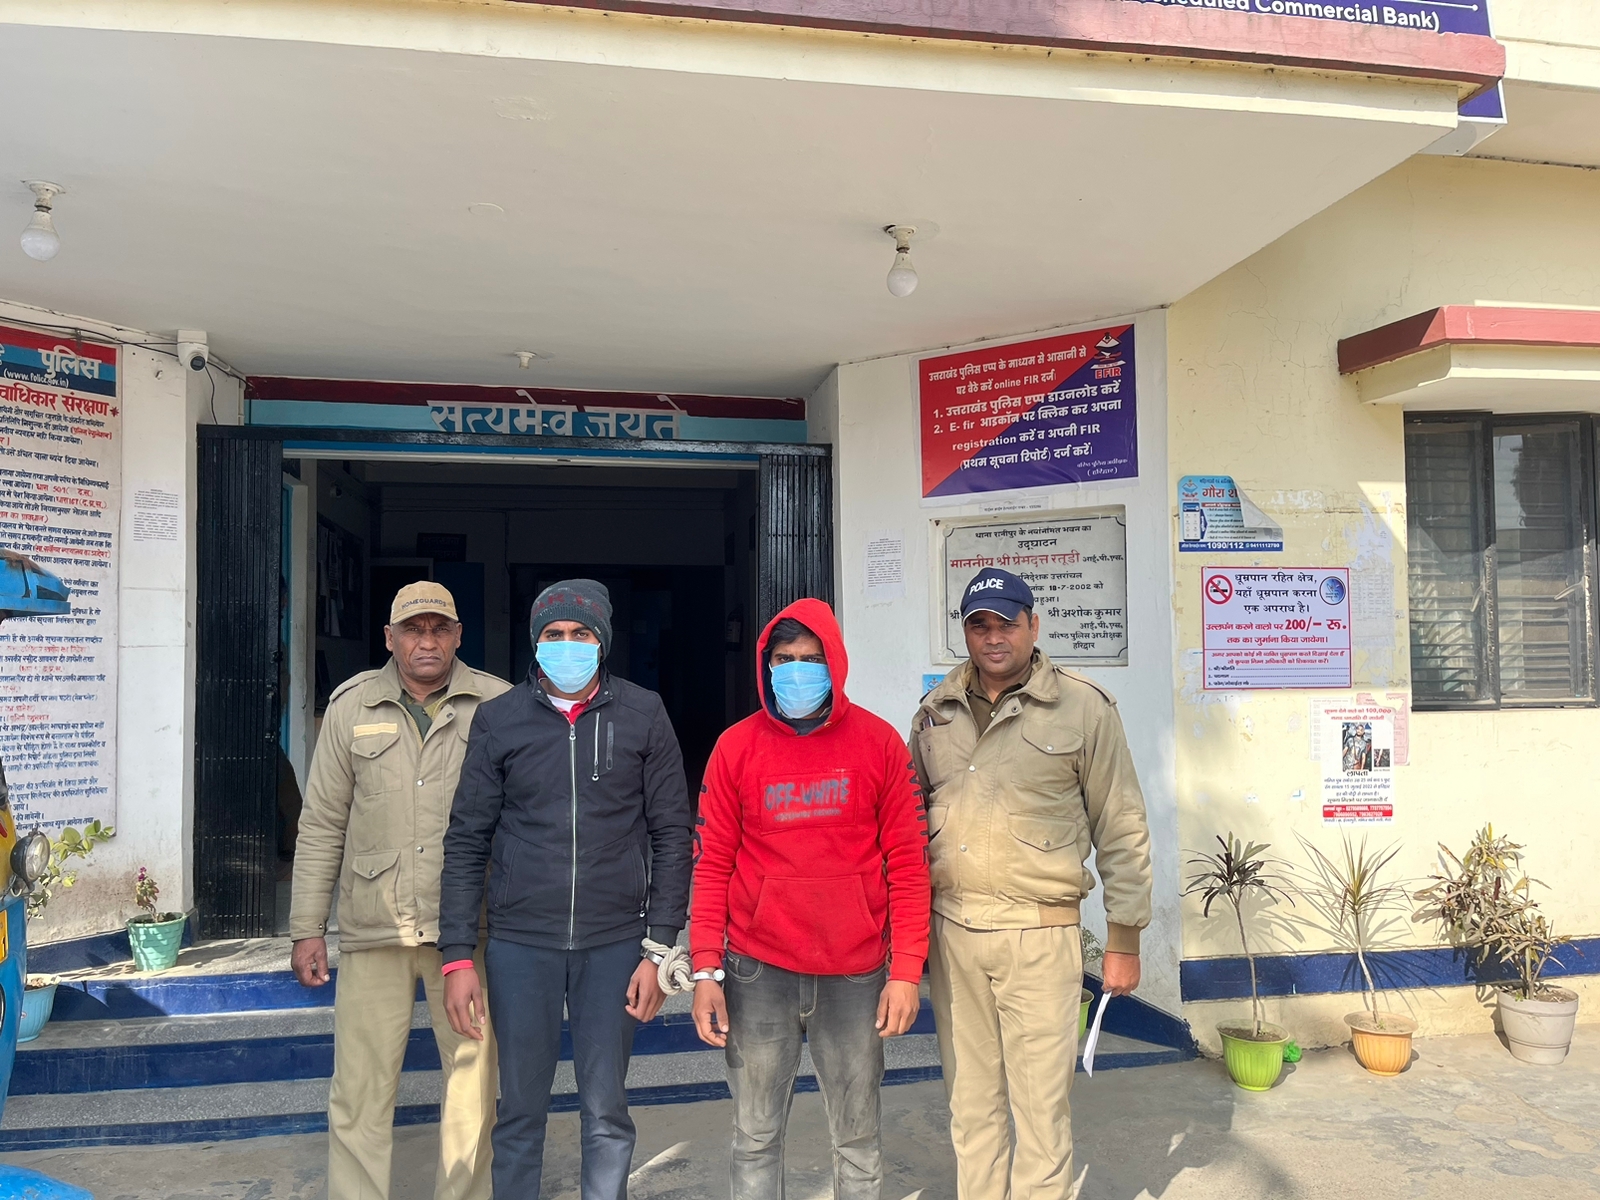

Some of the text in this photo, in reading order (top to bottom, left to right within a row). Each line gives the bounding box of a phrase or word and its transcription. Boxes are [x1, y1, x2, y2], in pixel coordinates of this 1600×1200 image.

[1255, 0, 1379, 23] Commercial
[1383, 6, 1440, 33] Bank)
[38, 345, 102, 379] पुलिस
[929, 367, 957, 381] उत्तराखंड
[959, 363, 981, 380] पुलिस
[998, 358, 1006, 370] के
[1008, 356, 1035, 369] माध्यम
[1037, 351, 1045, 364] से
[1047, 346, 1077, 362] आसानी
[1079, 344, 1087, 357] से
[980, 378, 993, 391] करें
[994, 378, 1021, 390] online
[1023, 374, 1039, 385] FIR
[61, 392, 109, 416] संरक्षण
[933, 409, 943, 418] 1.
[946, 399, 987, 417] उत्तराखंड
[990, 395, 1021, 414] पुलिस
[1048, 384, 1098, 403] डाउनलोड
[1101, 379, 1122, 394] करें
[427, 389, 688, 439] सत्यमेव जयते
[933, 425, 943, 434] 2.
[963, 420, 975, 430] fir
[980, 411, 1019, 427] आइकॉन
[1022, 411, 1035, 421] पर
[1038, 405, 1069, 420] क्लिक
[1071, 403, 1088, 414] कर
[1091, 399, 1122, 412] अपना
[952, 423, 1101, 452] registration करें व अपनी FIR
[960, 442, 1093, 471] (प्रथम सूचना रिपोर्ट) दर्ज करें।
[1202, 484, 1226, 499] गौरा
[975, 531, 992, 539] थाना
[994, 528, 1017, 539] रानीपुर
[1018, 527, 1027, 536] के
[1062, 525, 1080, 533] भवन
[1017, 538, 1058, 551] उद्घाटन
[1207, 541, 1244, 549] 1090/112
[950, 553, 994, 568] माननीय
[997, 552, 1011, 566] श्री
[1012, 551, 1049, 568] प्रेमदत्त
[1051, 570, 1082, 580] उत्तरांचल
[1235, 573, 1268, 586] धूम्रपान
[1271, 571, 1294, 583] रहित
[969, 578, 1004, 595] POLICE
[1093, 580, 1103, 590] को
[1235, 586, 1252, 598] यहाँ
[1256, 589, 1289, 601] धूम्रपान
[1292, 589, 1317, 597] करना
[950, 610, 960, 620] श्री
[1048, 605, 1122, 620] श्री अशोक कुमार
[1243, 600, 1310, 615] एक अपराध है।
[1235, 621, 1253, 631] करने
[1274, 623, 1284, 631] पर
[1285, 616, 1322, 632] 200/-
[1049, 631, 1122, 641] वरिष्ठ पुलिस अधीक्षक
[1280, 634, 1299, 643] किया
[1073, 642, 1095, 651] हरिद्वार
[765, 778, 849, 811] OFF-WHITE
